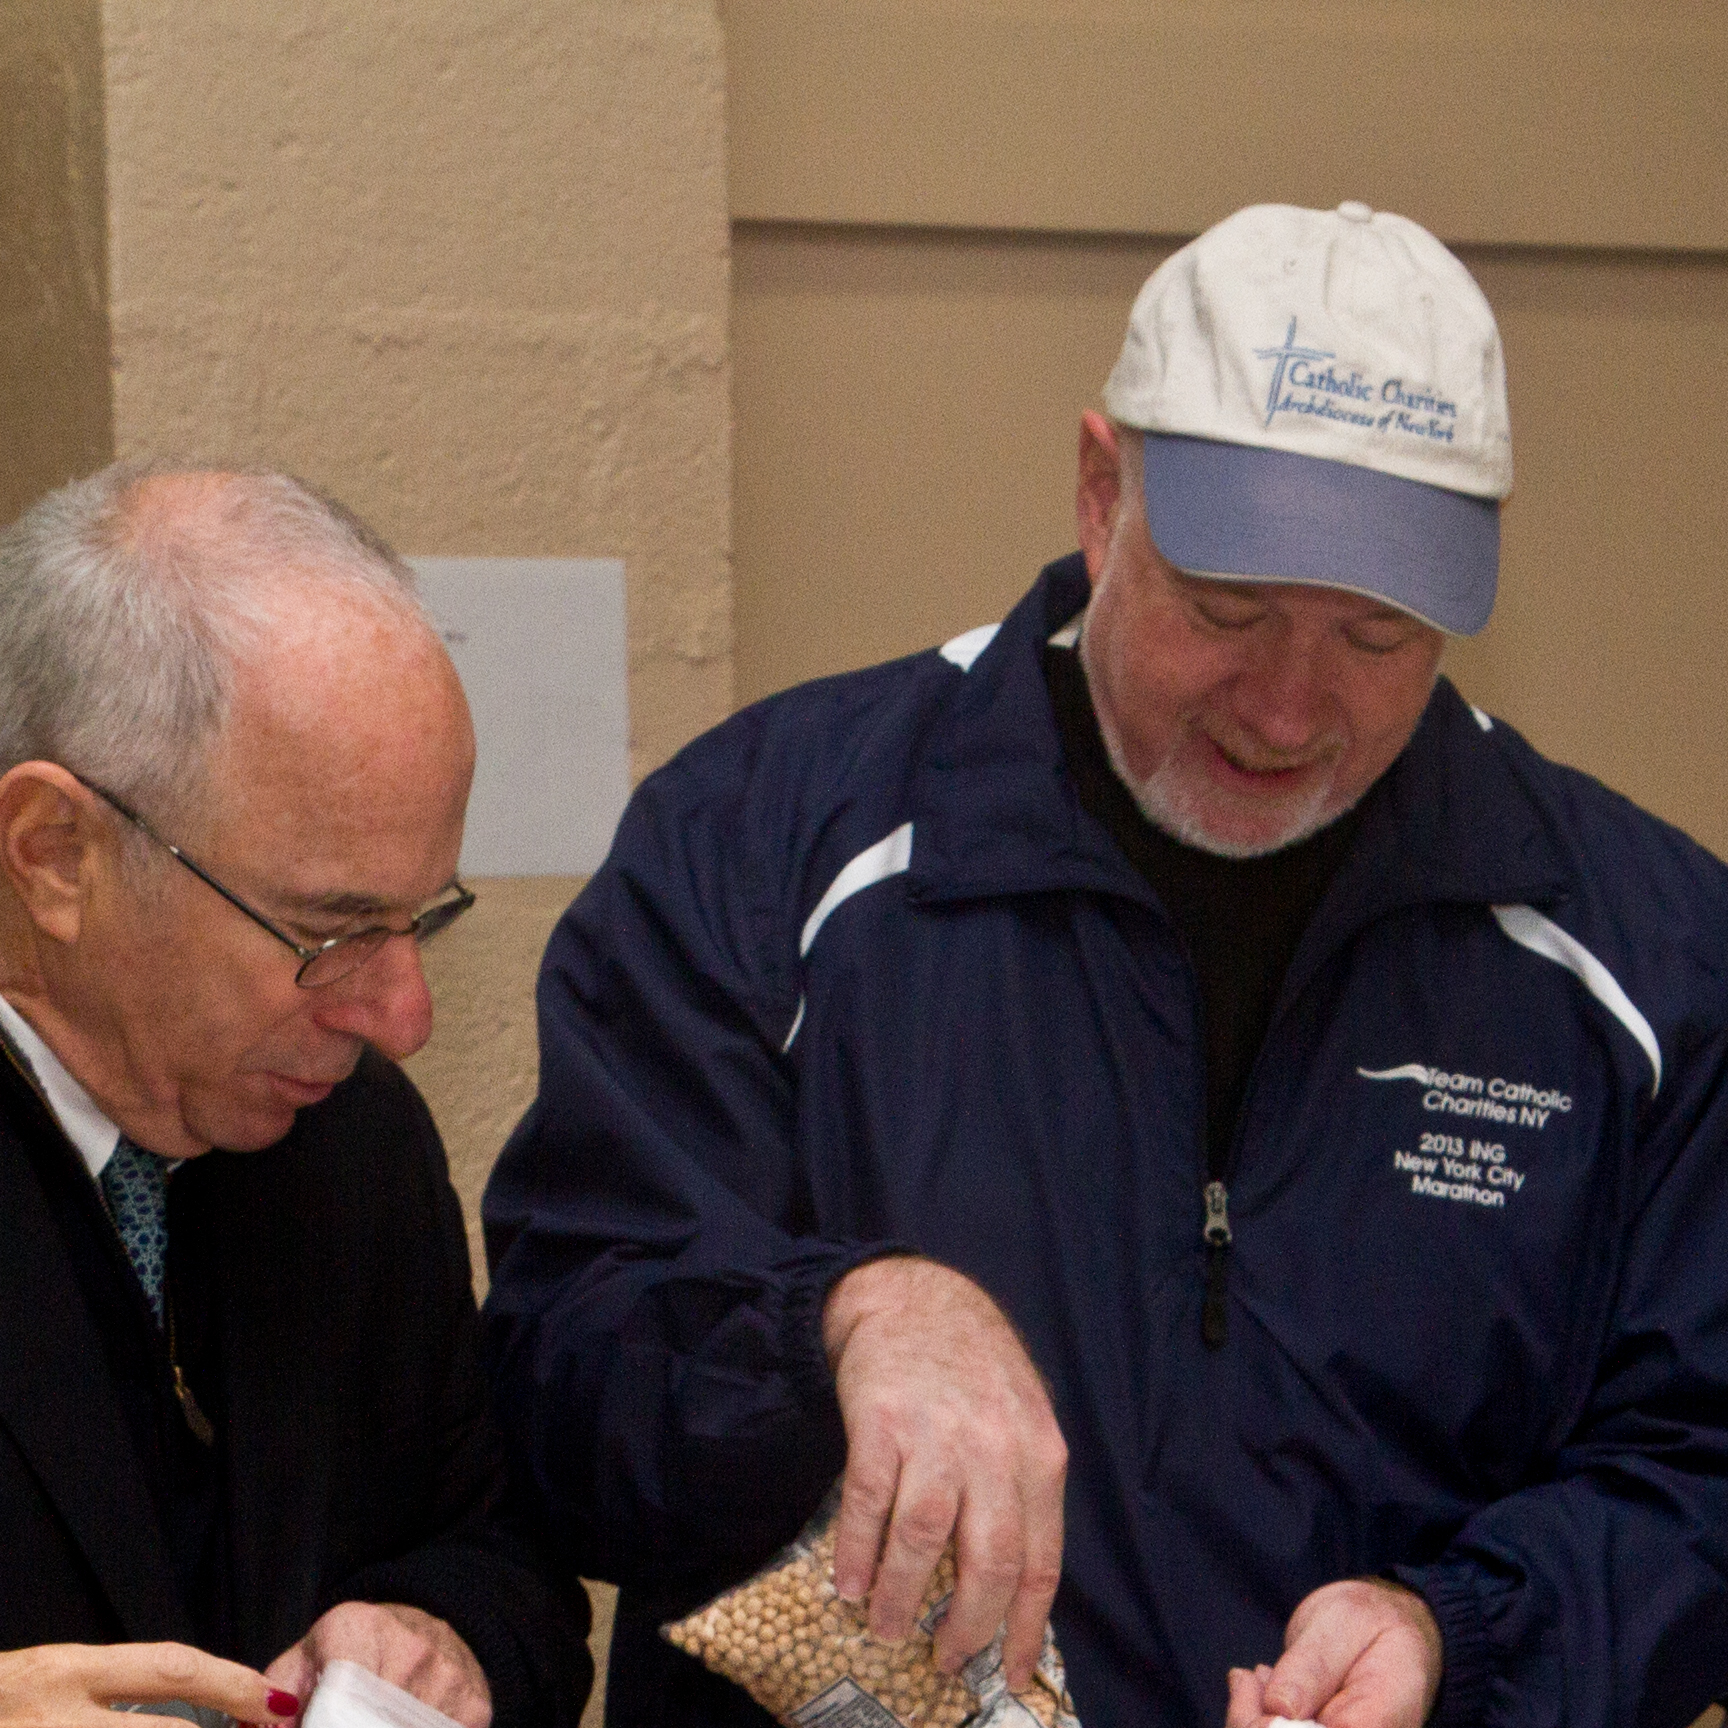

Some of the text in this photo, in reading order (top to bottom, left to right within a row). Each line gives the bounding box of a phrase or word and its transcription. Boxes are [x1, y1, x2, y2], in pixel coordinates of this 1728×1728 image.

[1289, 361, 1456, 417] Catholic Charities
[1423, 1090, 1550, 1129] Charities NY
[1488, 1078, 1572, 1112] Catholic
[1420, 1132, 1507, 1163] 2013 ING
[1395, 1150, 1525, 1192] New York City
[1412, 1174, 1505, 1207] Marathon
